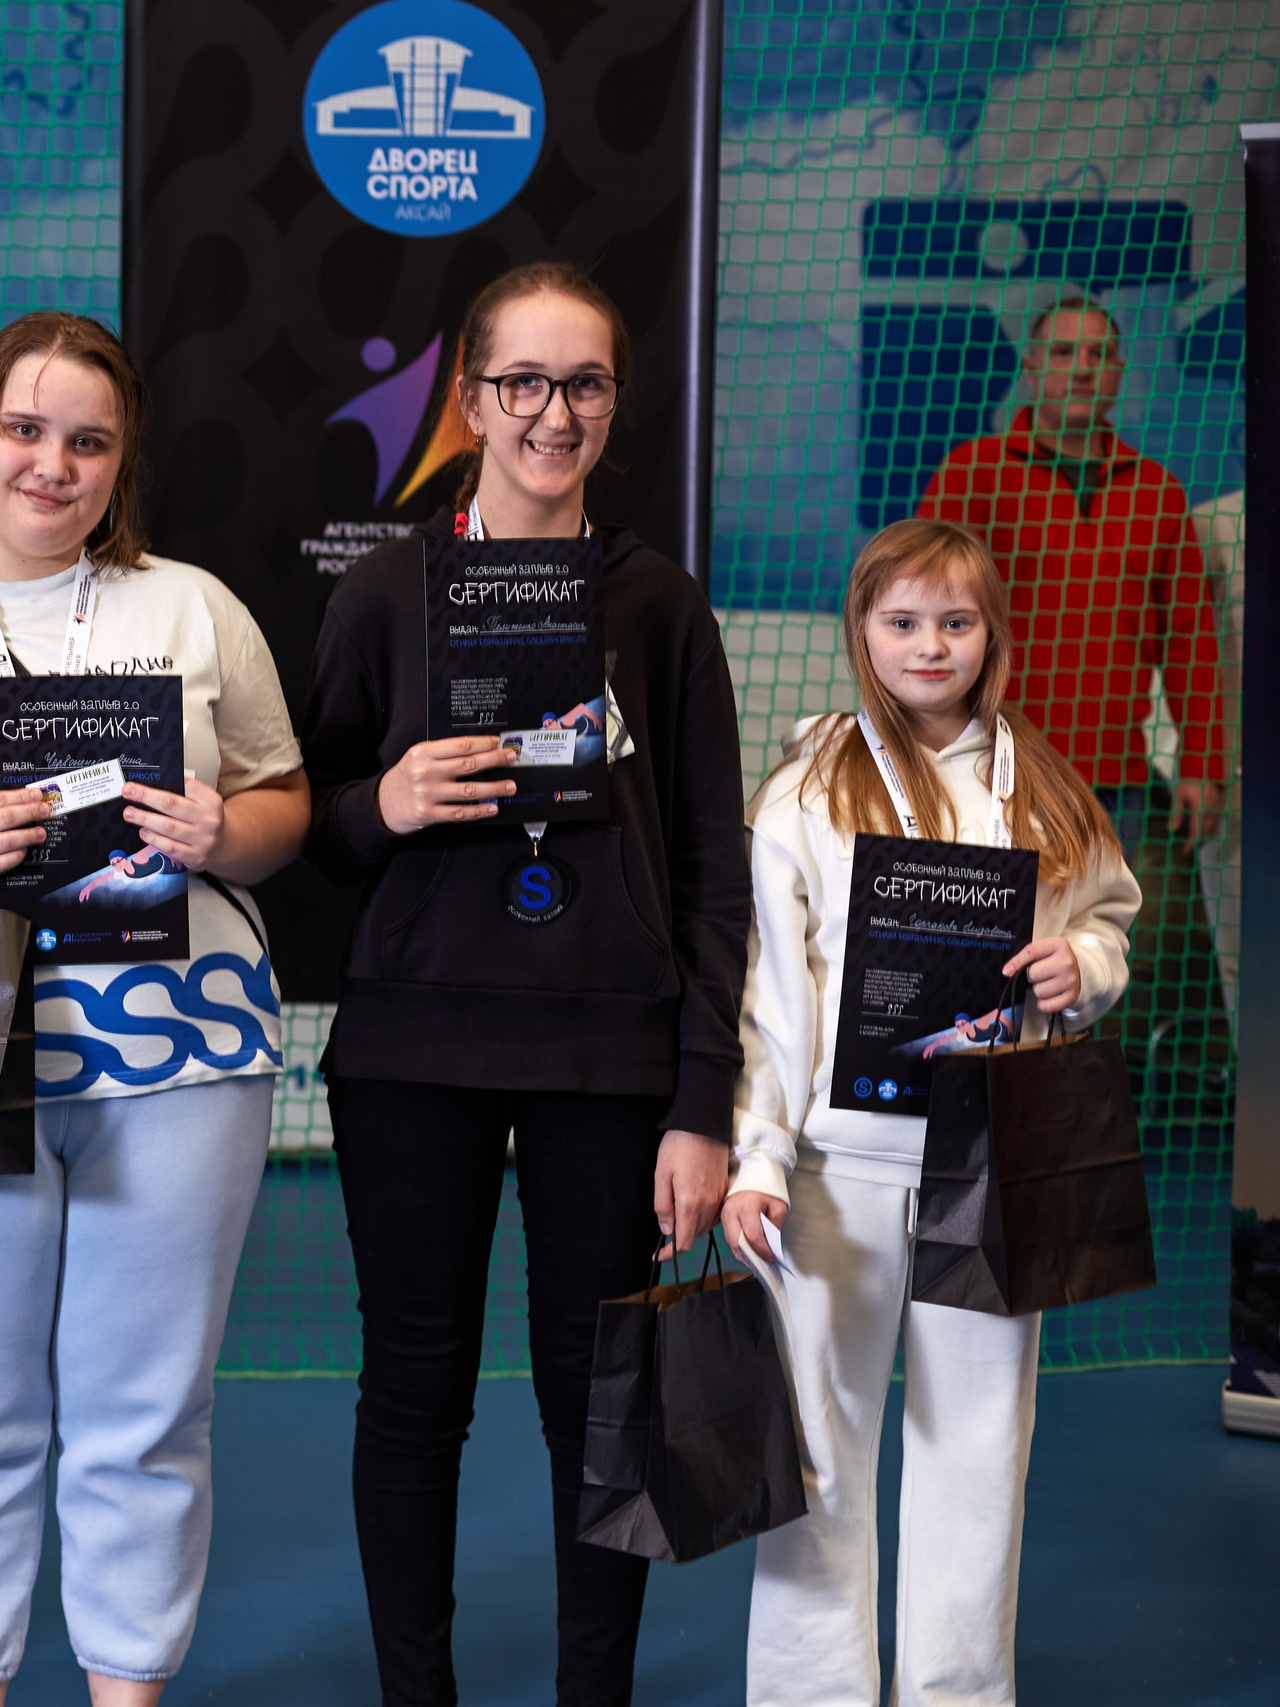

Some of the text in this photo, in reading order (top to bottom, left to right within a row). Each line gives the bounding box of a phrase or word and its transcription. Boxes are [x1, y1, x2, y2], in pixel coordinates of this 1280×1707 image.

[367, 147, 479, 175] ДВОРЕЦ
[366, 174, 479, 201] СПОРТА
[555, 564, 569, 576] 2.0
[448, 579, 585, 606] СЕРТИФИКАТ
[124, 701, 140, 711] 2.0
[2, 716, 160, 742] СЕРТИФИКАТ
[519, 865, 552, 910] S
[986, 871, 1001, 882] 2.0
[873, 876, 1017, 910] СЕРТИФИКАТ
